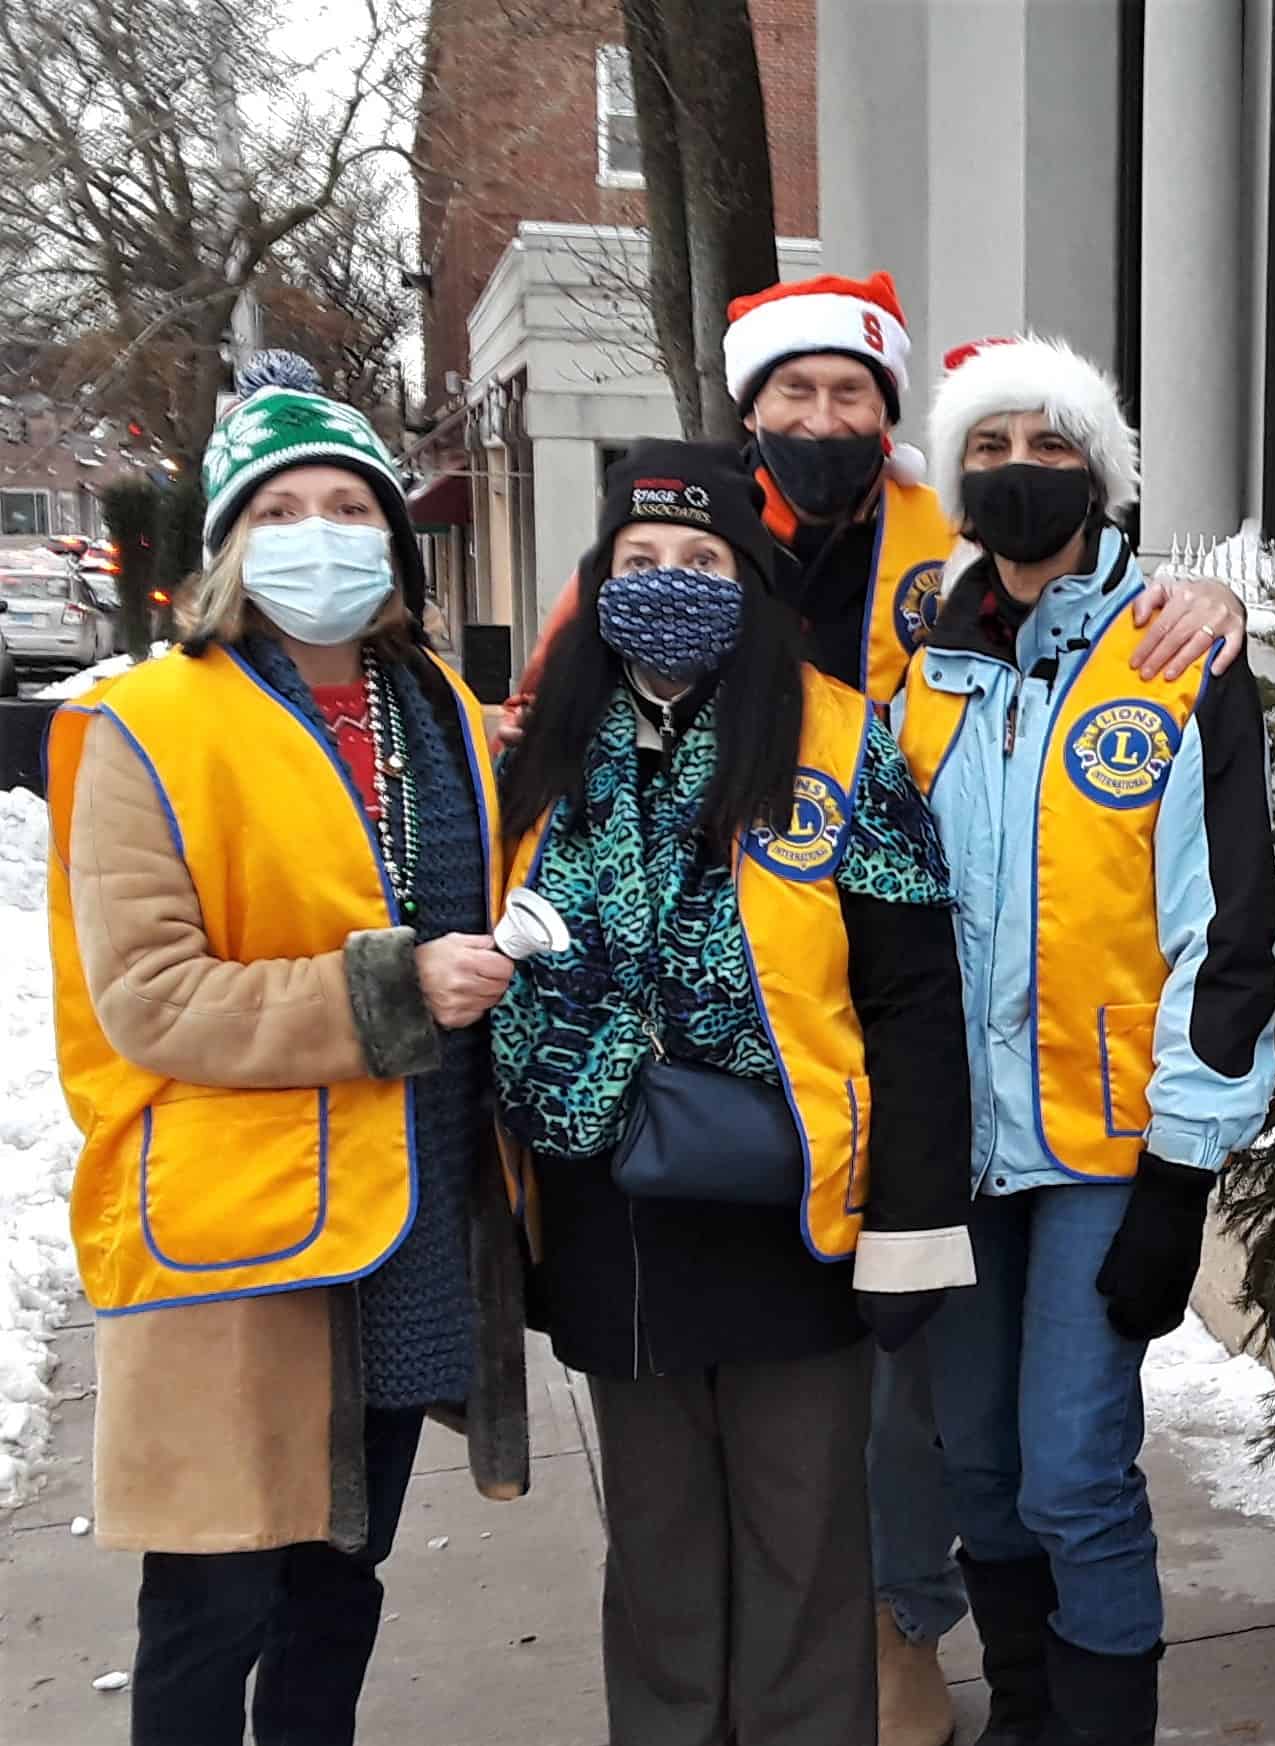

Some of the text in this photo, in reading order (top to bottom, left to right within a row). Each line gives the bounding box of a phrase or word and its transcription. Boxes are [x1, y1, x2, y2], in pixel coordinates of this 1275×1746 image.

[863, 311, 884, 353] S
[632, 488, 679, 504] STAGE
[1098, 708, 1158, 729] LIONS
[1110, 731, 1138, 766] L
[787, 802, 815, 836] L
